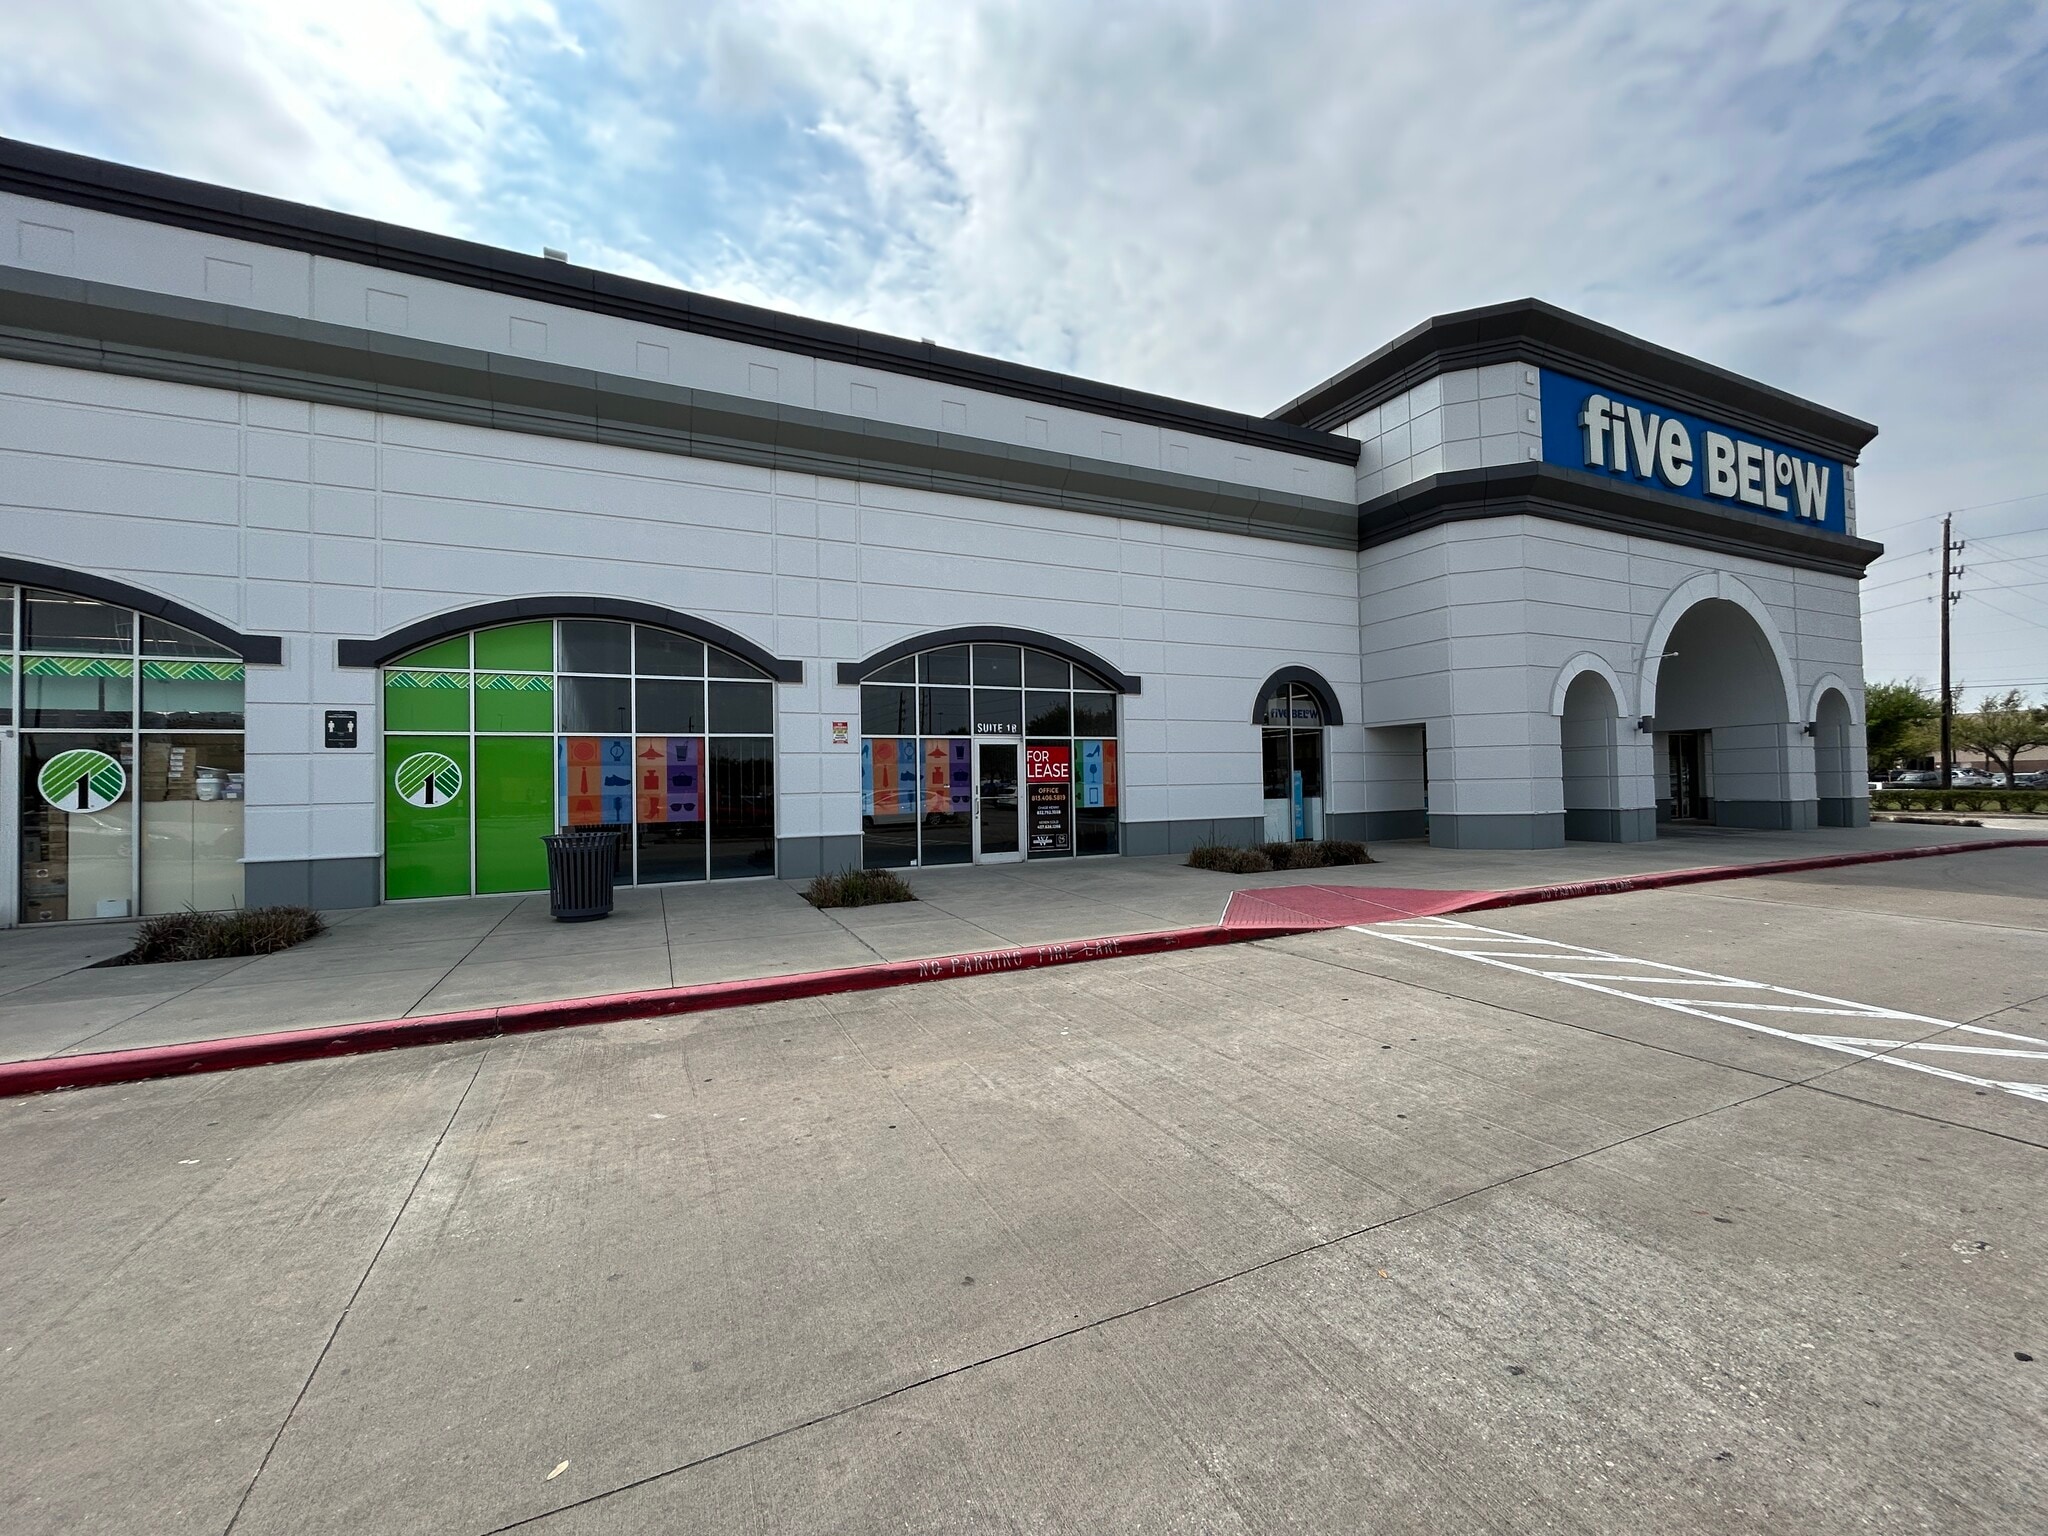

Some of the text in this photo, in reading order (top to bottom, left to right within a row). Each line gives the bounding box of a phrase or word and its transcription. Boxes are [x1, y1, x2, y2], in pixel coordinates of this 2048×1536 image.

[1702, 431, 1829, 521] BELOW
[977, 723, 1003, 733] SUITE
[1027, 750, 1049, 762] FOR
[1027, 763, 1069, 778] LEASE
[918, 939, 1123, 977] NO PARKING FIRE LANE
